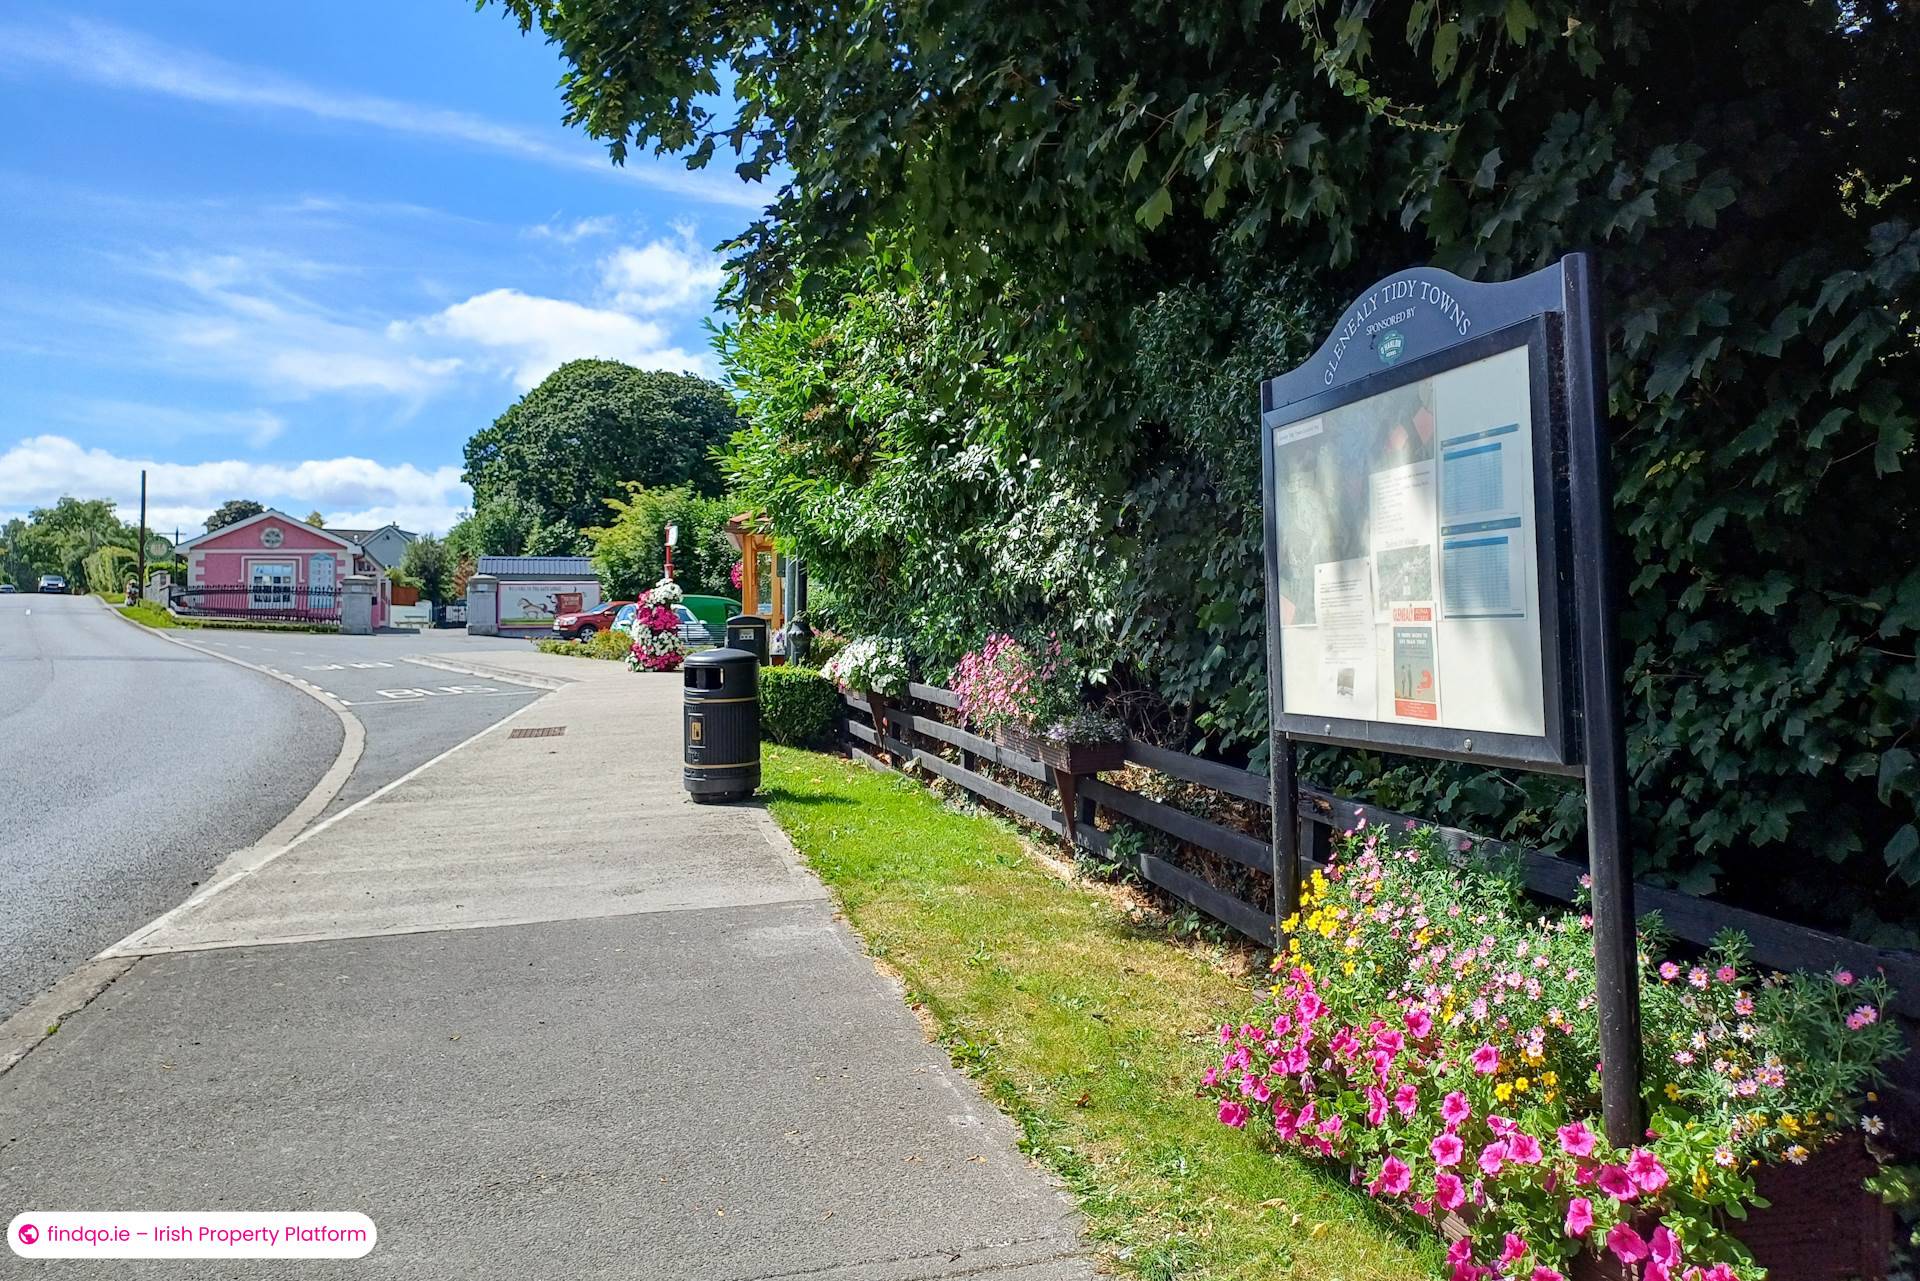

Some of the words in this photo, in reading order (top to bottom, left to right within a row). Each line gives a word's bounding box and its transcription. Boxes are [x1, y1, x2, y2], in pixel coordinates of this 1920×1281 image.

[1324, 293, 1378, 386] GLENEALY
[1382, 280, 1417, 304] TIDY
[1420, 281, 1472, 336] TOWNS
[1366, 311, 1406, 336] SPONSORED
[1406, 306, 1416, 318] BY
[376, 684, 498, 699] BUS
